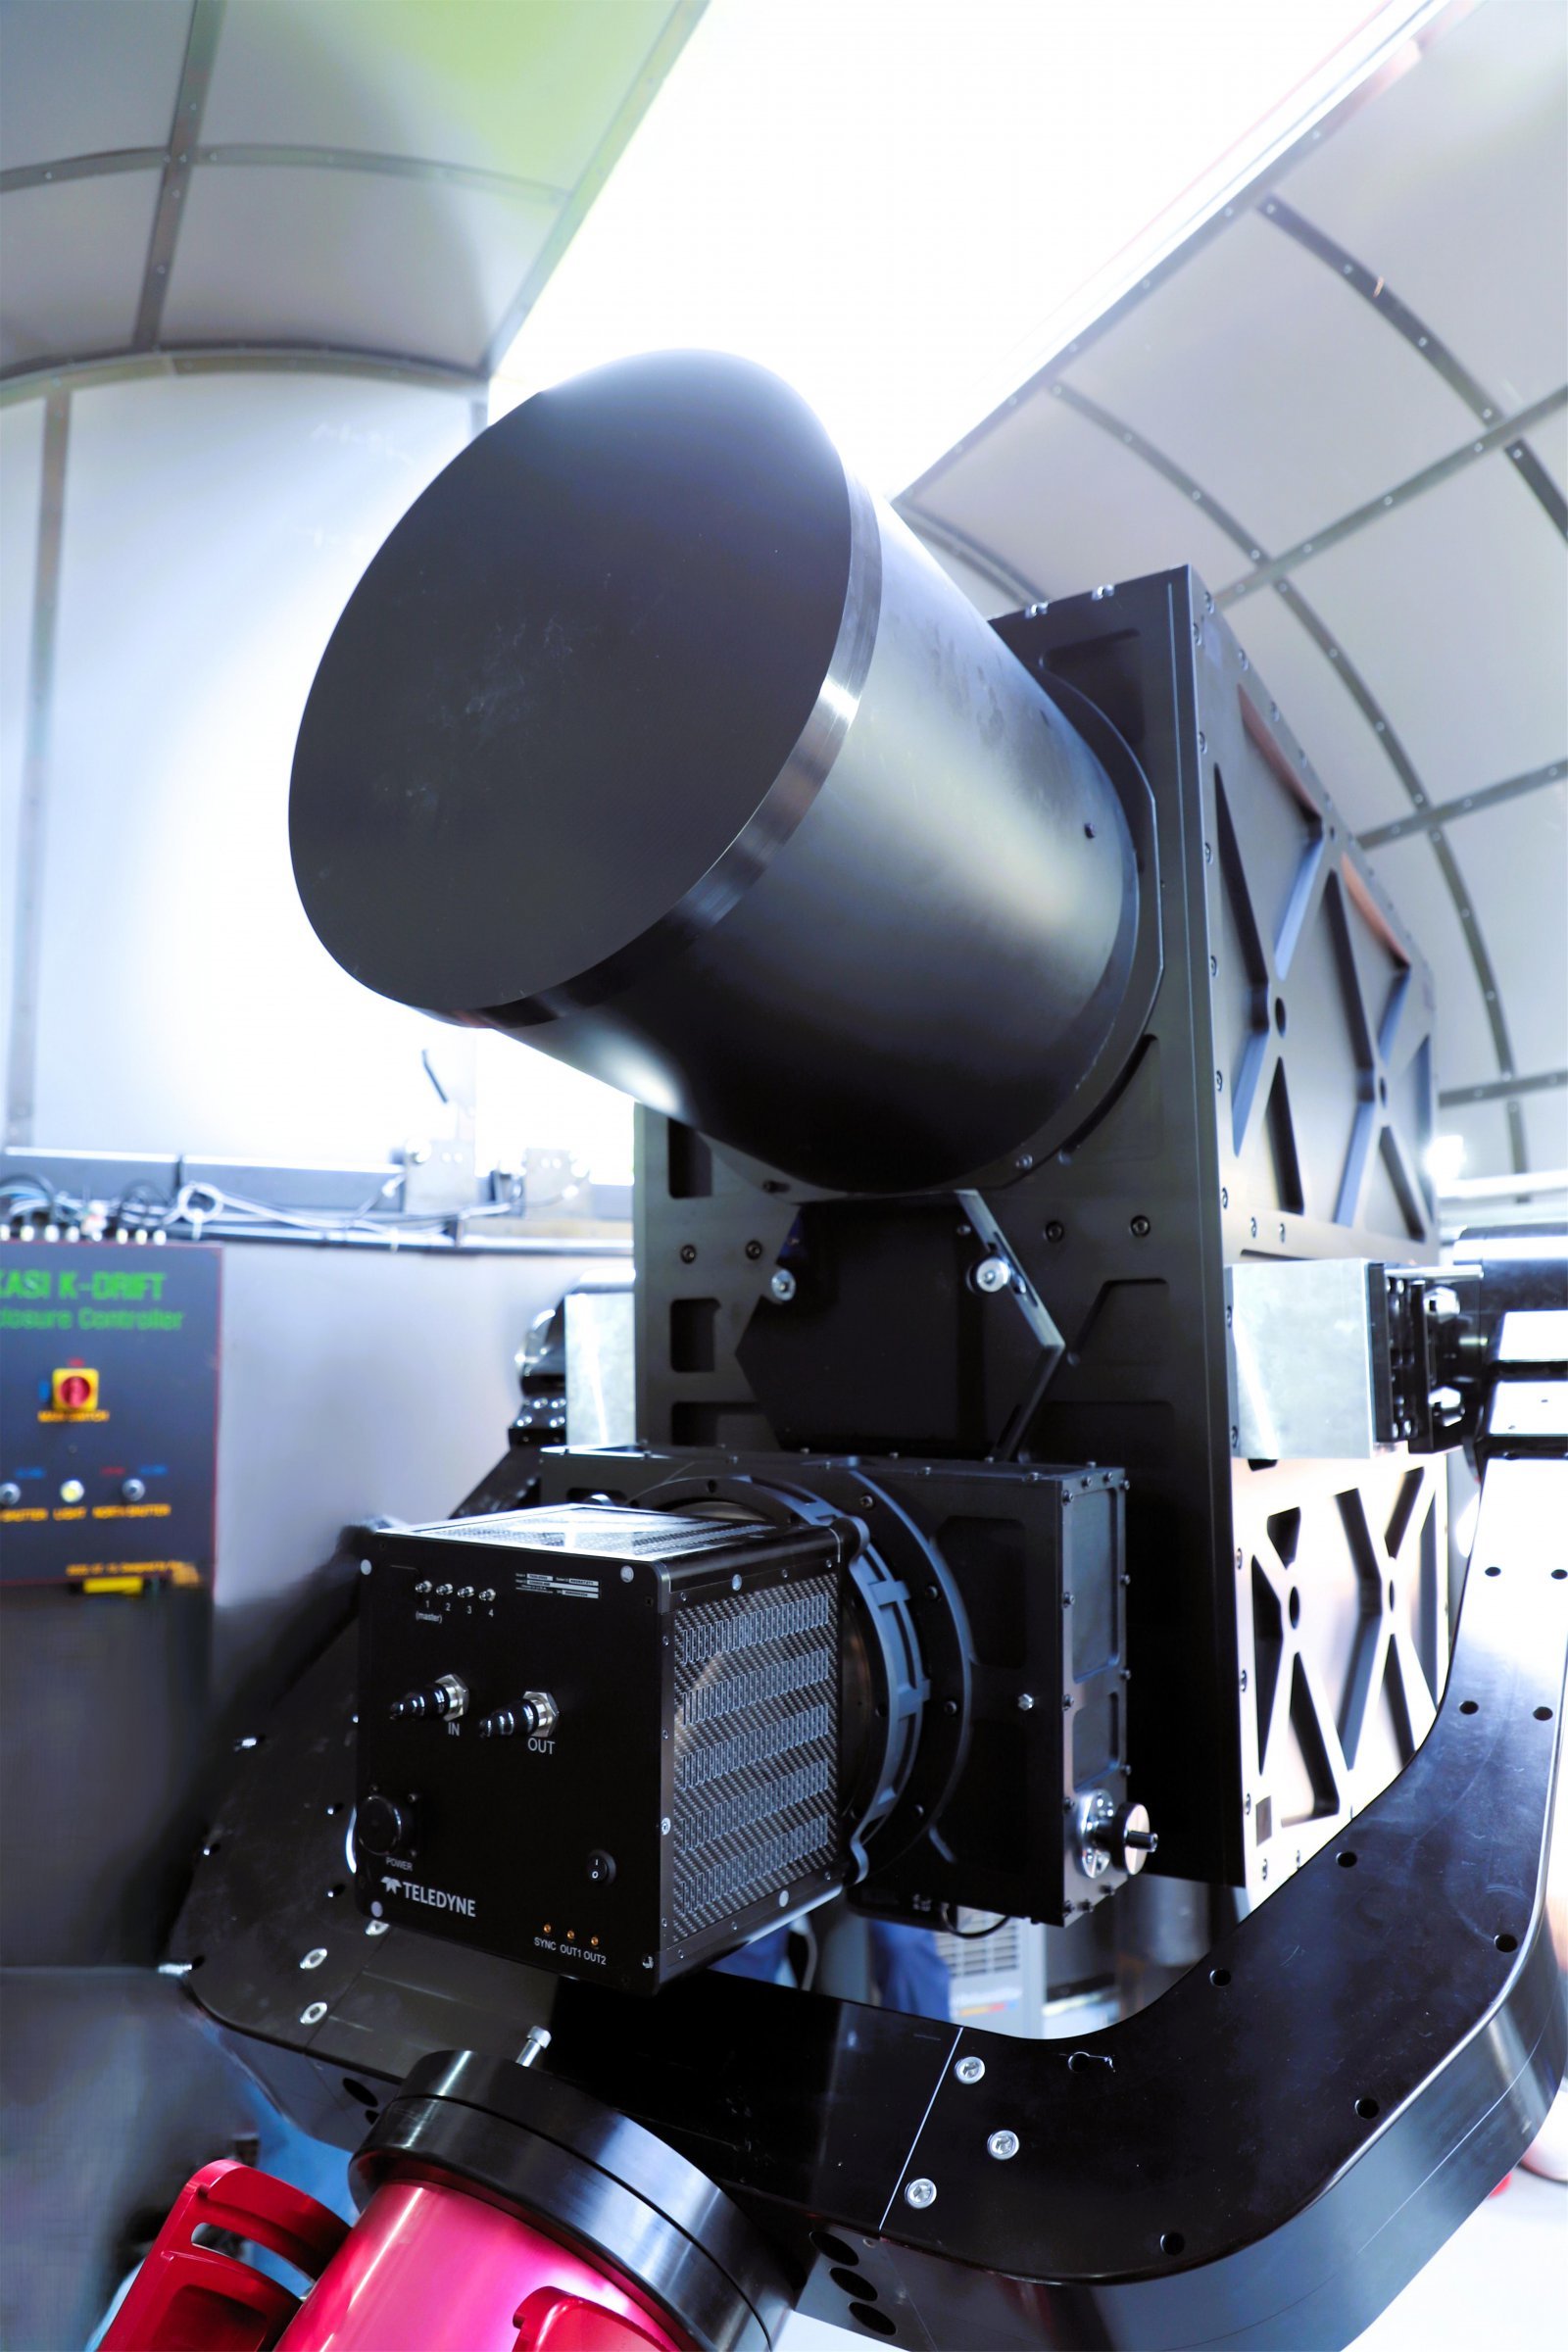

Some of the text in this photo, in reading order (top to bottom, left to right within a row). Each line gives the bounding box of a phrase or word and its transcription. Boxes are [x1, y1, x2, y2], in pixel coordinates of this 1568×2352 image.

[78, 1306, 184, 1331] Controller
[445, 1602, 451, 1611] 2
[466, 1605, 472, 1614] 3
[488, 1608, 494, 1617] 4
[448, 1722, 460, 1737] IN
[527, 1738, 556, 1754] OUT
[385, 1857, 414, 1872] POWER
[403, 1881, 476, 1918] TELEDYNE
[534, 1936, 607, 1966] SYNC OUT1 OUT2
